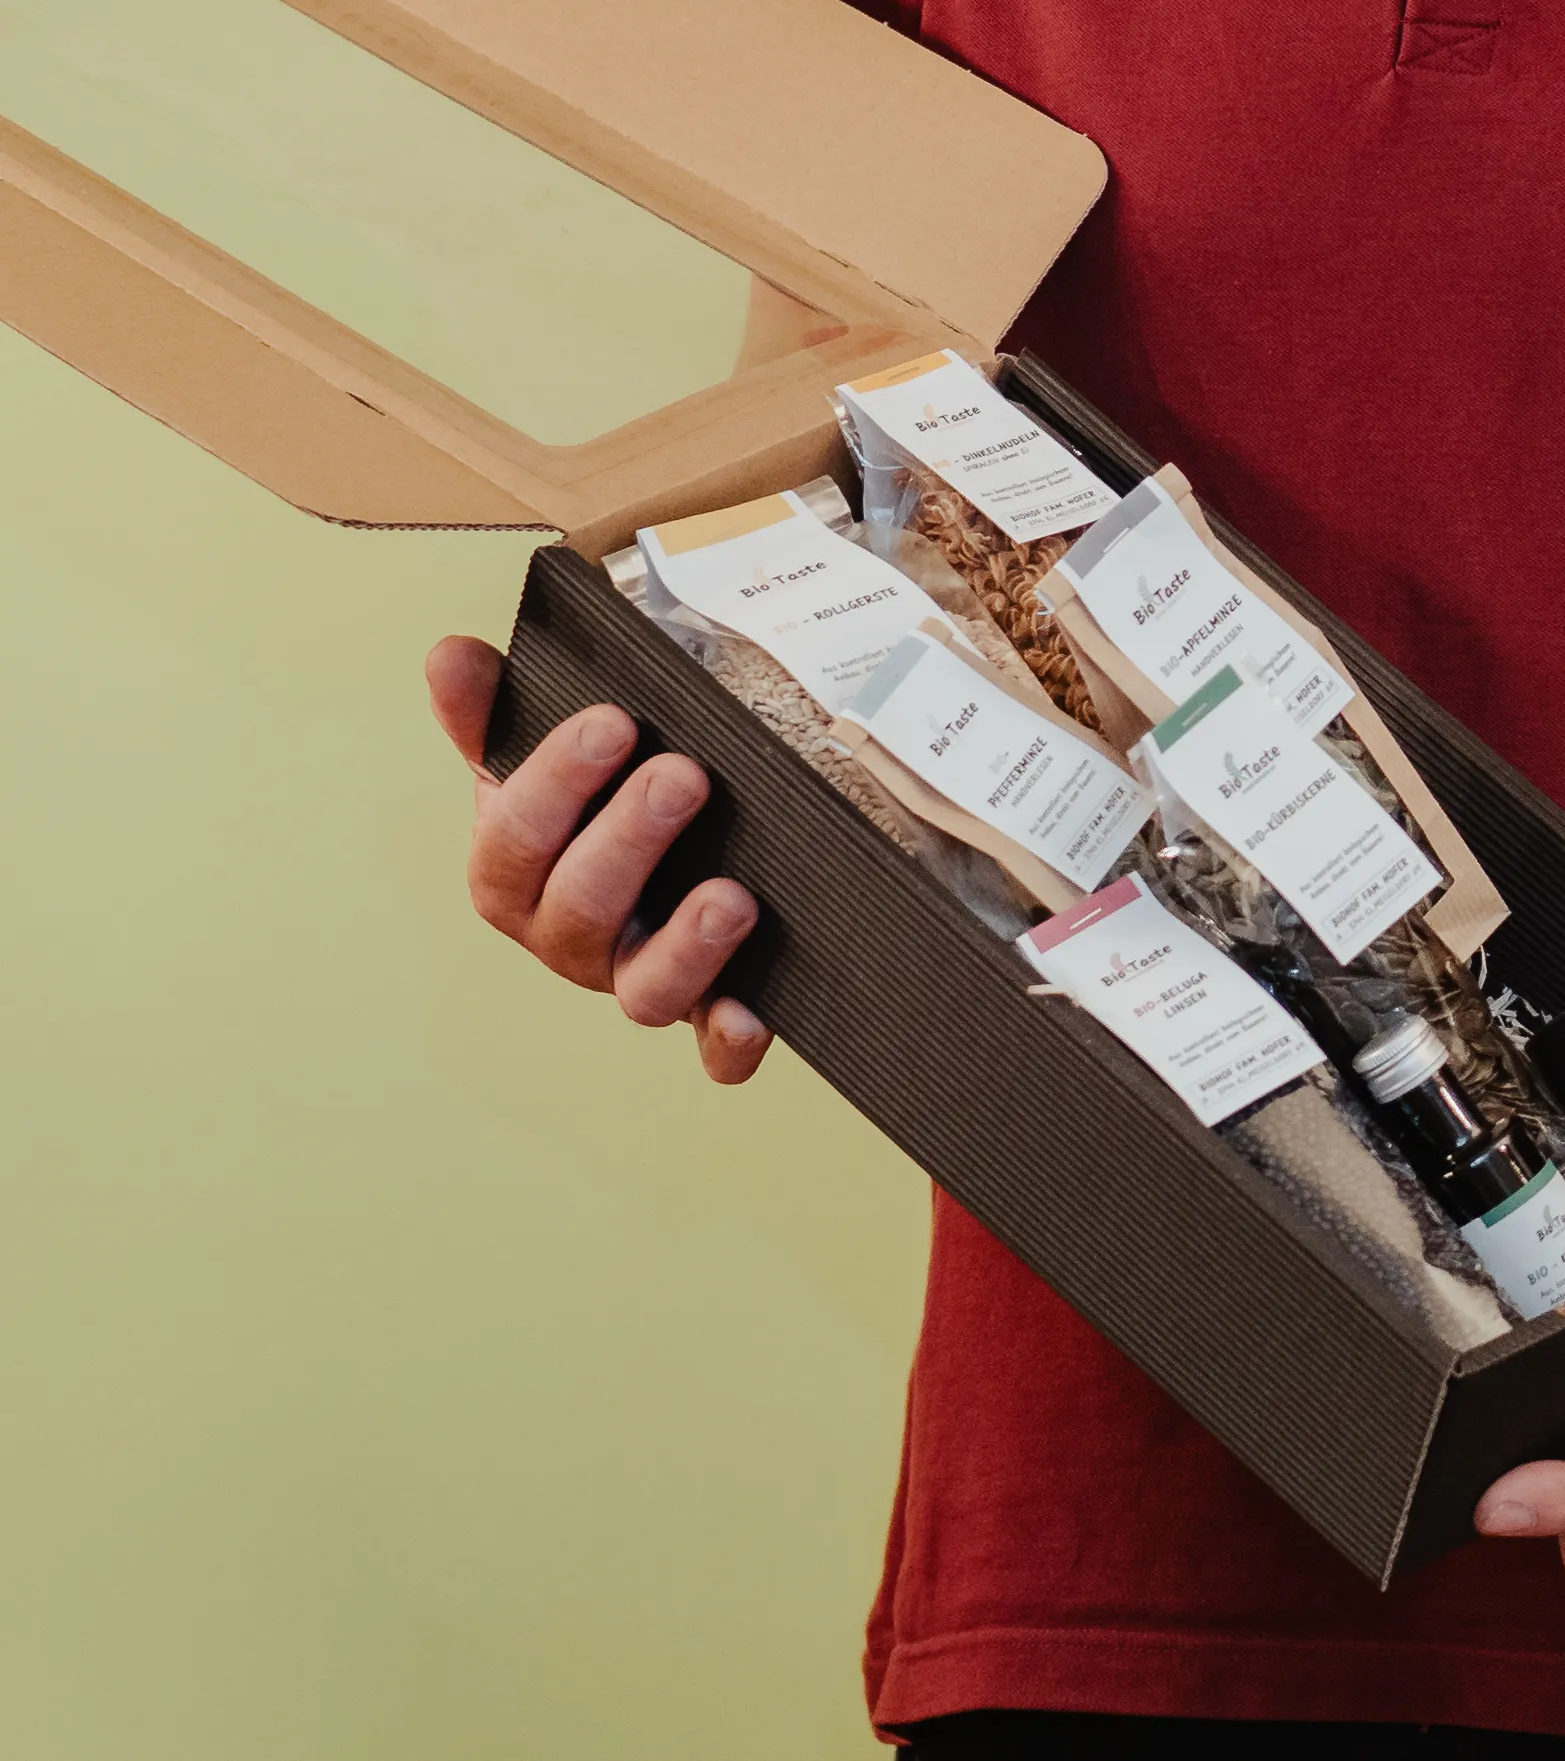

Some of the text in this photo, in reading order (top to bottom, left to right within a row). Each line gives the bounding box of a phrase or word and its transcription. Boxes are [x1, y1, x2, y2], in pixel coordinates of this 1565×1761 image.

[915, 406, 981, 433] Bio Taste
[961, 430, 1041, 463] DINKELNUDELN
[740, 559, 828, 599] Bio Taste
[1133, 602, 1156, 626] Bio
[1154, 567, 1192, 601] Taste
[813, 586, 899, 621] ROLLGERSTE
[1296, 674, 1323, 703] HOFER
[929, 701, 979, 757] Bio Taste
[987, 736, 1049, 809] PFEFFERMINZE
[1218, 775, 1243, 800] Bio
[1240, 743, 1281, 780] Taste
[1101, 968, 1127, 988] Bio
[1128, 943, 1173, 971] Taste
[1164, 989, 1208, 1019] LINSEN
[1536, 1224, 1553, 1243] Bio
[1527, 1265, 1549, 1286] BIO
